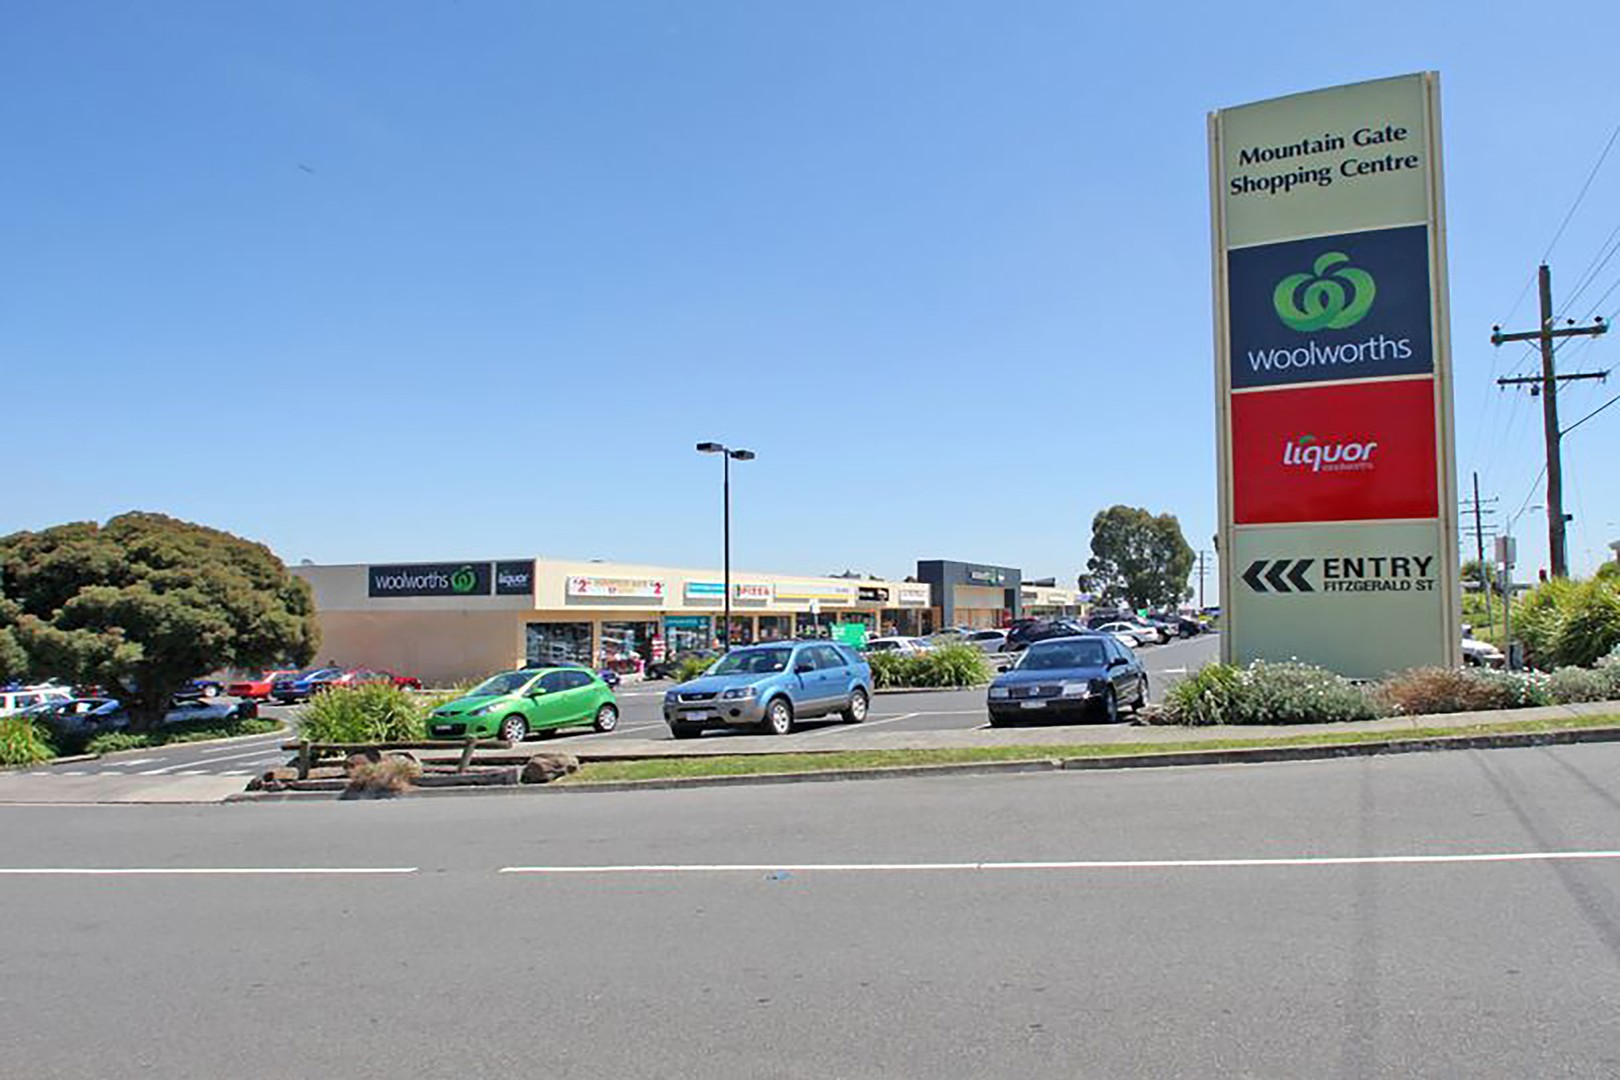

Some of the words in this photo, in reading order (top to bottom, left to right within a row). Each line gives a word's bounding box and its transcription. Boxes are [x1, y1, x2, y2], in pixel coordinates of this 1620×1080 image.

[1239, 133, 1345, 166] Mountain
[1353, 125, 1408, 147] Gate
[1230, 166, 1332, 195] Shopping
[1340, 154, 1419, 178] Centre
[1283, 441, 1378, 472] liquor
[1323, 556, 1433, 578] ENTRY
[1323, 580, 1412, 592] FITZGERALD
[1415, 579, 1436, 592] ST
